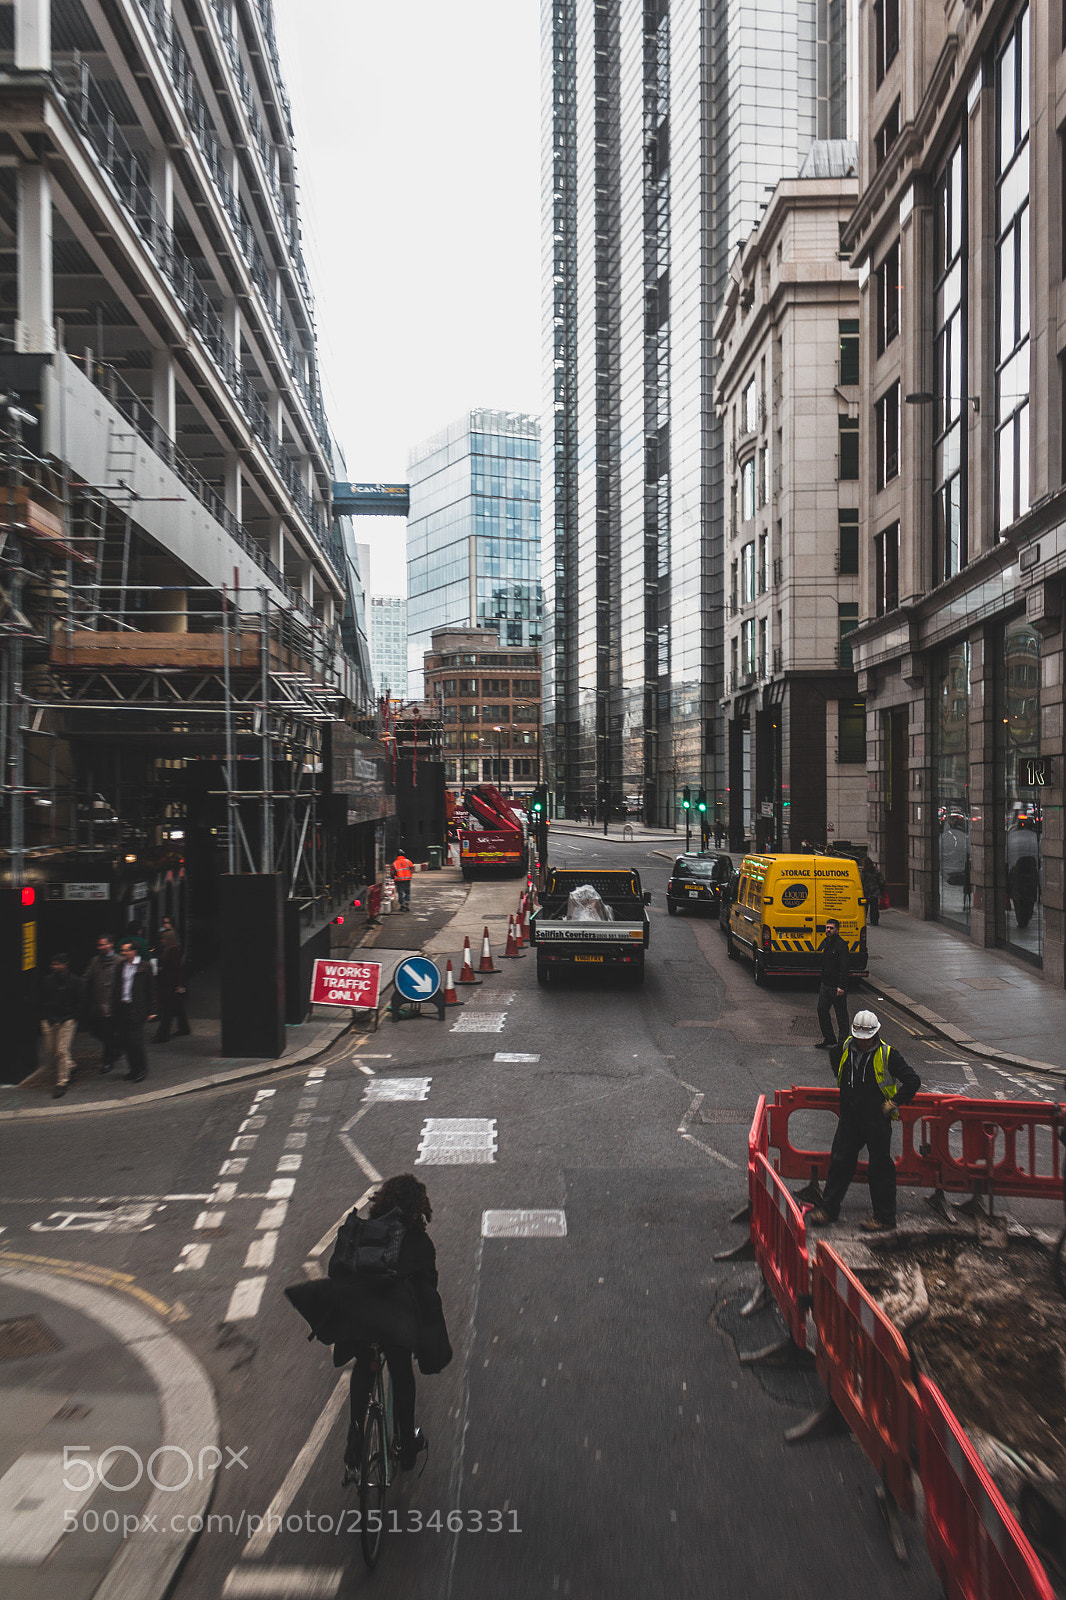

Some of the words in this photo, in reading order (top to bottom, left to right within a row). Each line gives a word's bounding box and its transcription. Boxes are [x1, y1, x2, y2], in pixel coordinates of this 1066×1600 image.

[780, 869, 811, 877] STORAGE
[784, 891, 808, 899] LIQUID
[535, 930, 564, 939] Sailfish
[565, 930, 596, 939] Couriers
[324, 965, 371, 978] WORKS
[322, 977, 371, 991] TRAFFIC
[328, 989, 362, 1002] ONLY
